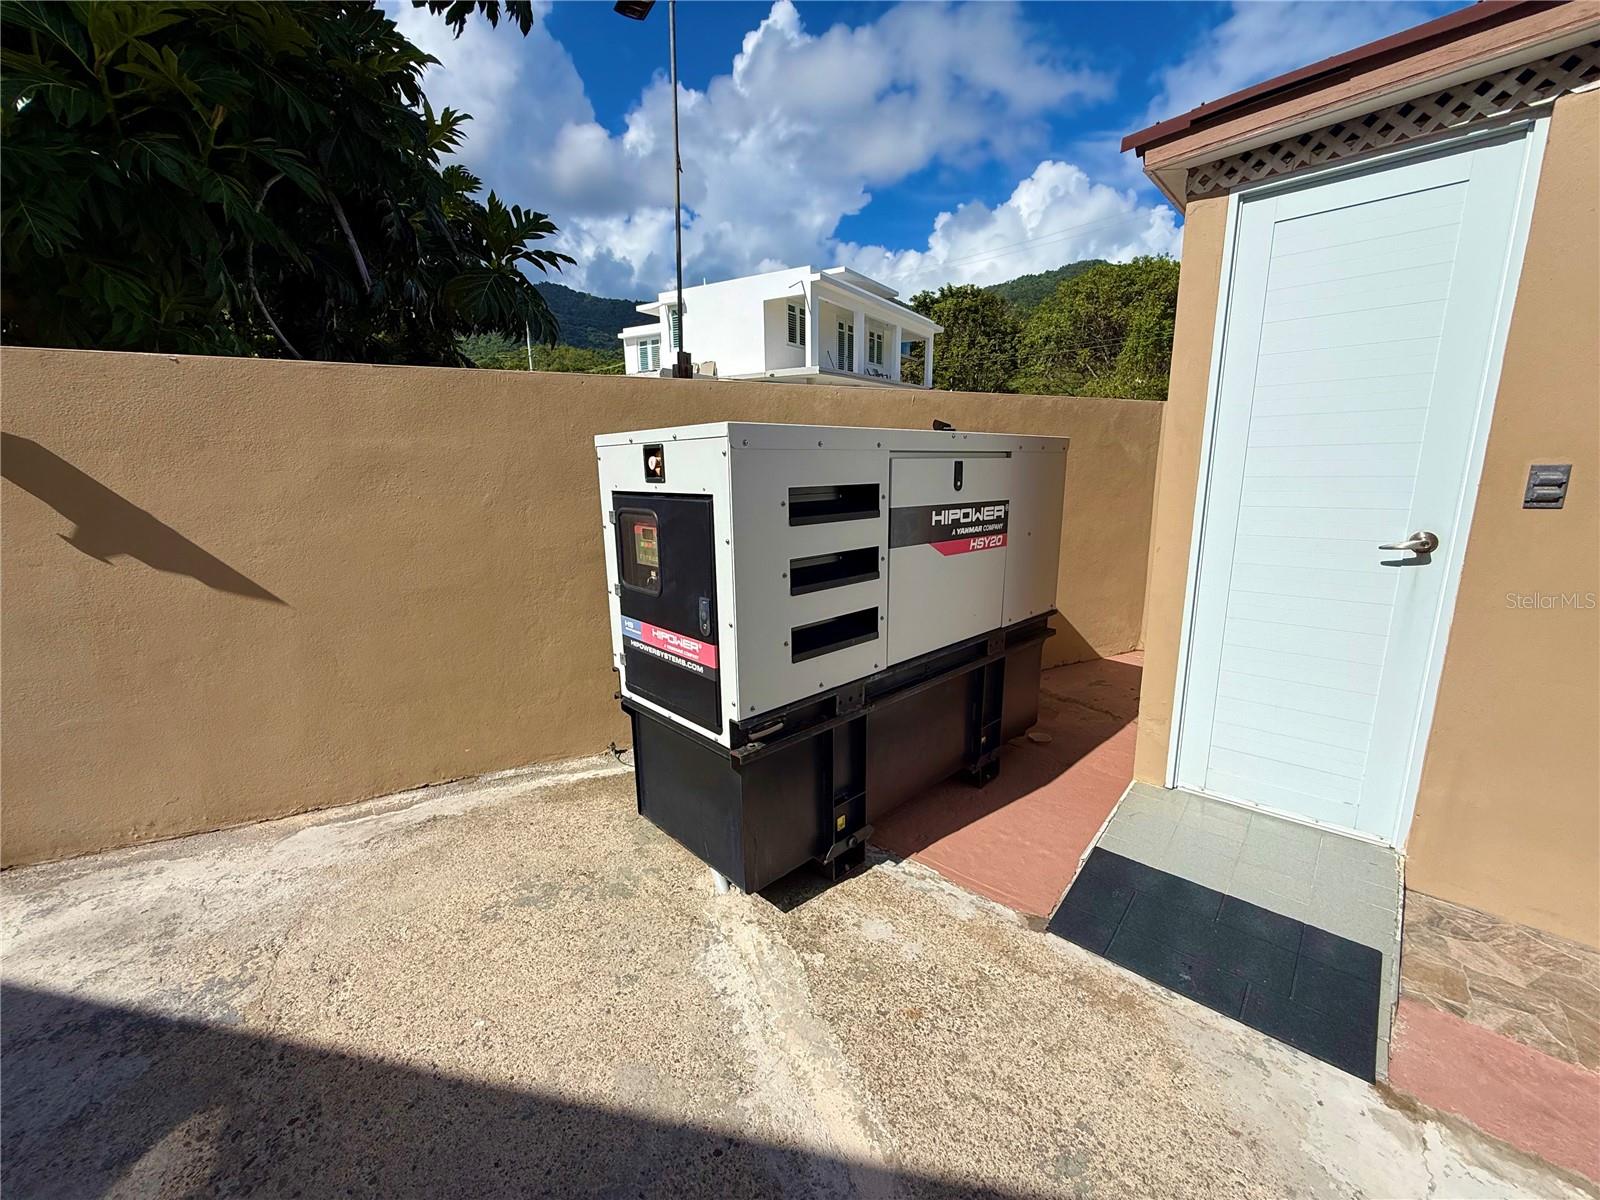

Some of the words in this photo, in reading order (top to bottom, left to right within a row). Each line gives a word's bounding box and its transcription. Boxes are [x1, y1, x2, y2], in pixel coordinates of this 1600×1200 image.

[957, 525, 982, 535] YANMAR
[983, 523, 1004, 532] COMPANY
[969, 535, 1003, 550] HSY20
